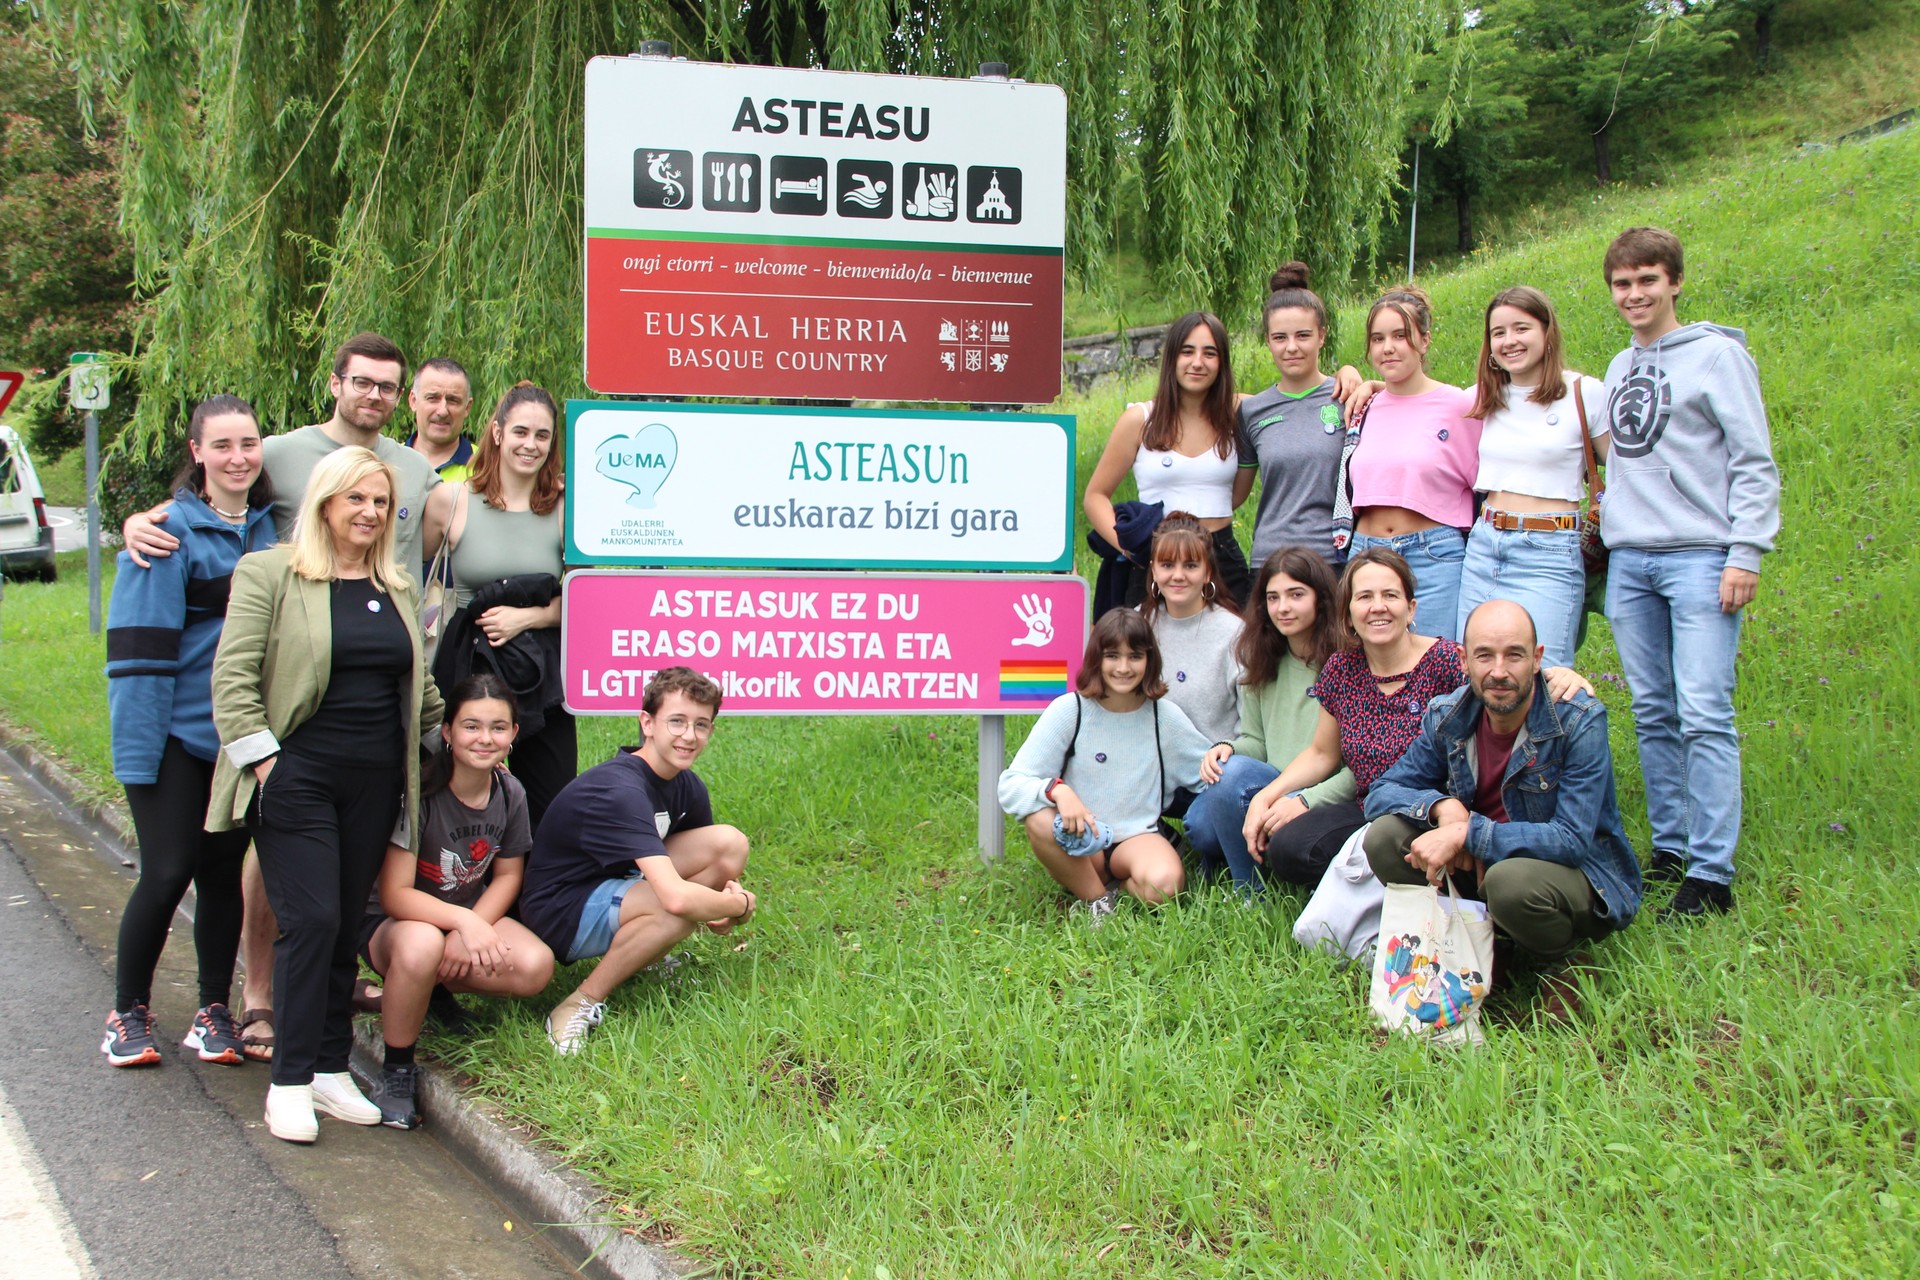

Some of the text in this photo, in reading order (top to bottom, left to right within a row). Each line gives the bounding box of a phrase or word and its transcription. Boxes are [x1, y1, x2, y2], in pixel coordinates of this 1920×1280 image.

[731, 96, 930, 143] ASTEASU
[623, 253, 661, 275] ongi
[666, 255, 714, 273] etorri
[734, 257, 808, 277] welcome
[827, 260, 932, 283] bienvenido/a
[951, 265, 1033, 285] bienvenue
[644, 311, 907, 343] EUSKAL HERRIA
[667, 347, 888, 372] BASQUE COUNTRY
[788, 440, 969, 485] ASTEASUn
[610, 528, 675, 537] EUSKALDUNEN
[621, 519, 665, 528] UDALERRI
[733, 497, 1019, 538] euskaraz bizi gara
[601, 537, 684, 546] MANKOMUNITATEA
[649, 589, 920, 621] ASTEASUK EZ DU
[611, 629, 952, 660] ERASO MATXISTA ETA
[813, 670, 979, 700] ONARTZEN
[449, 824, 482, 843] REBEL
